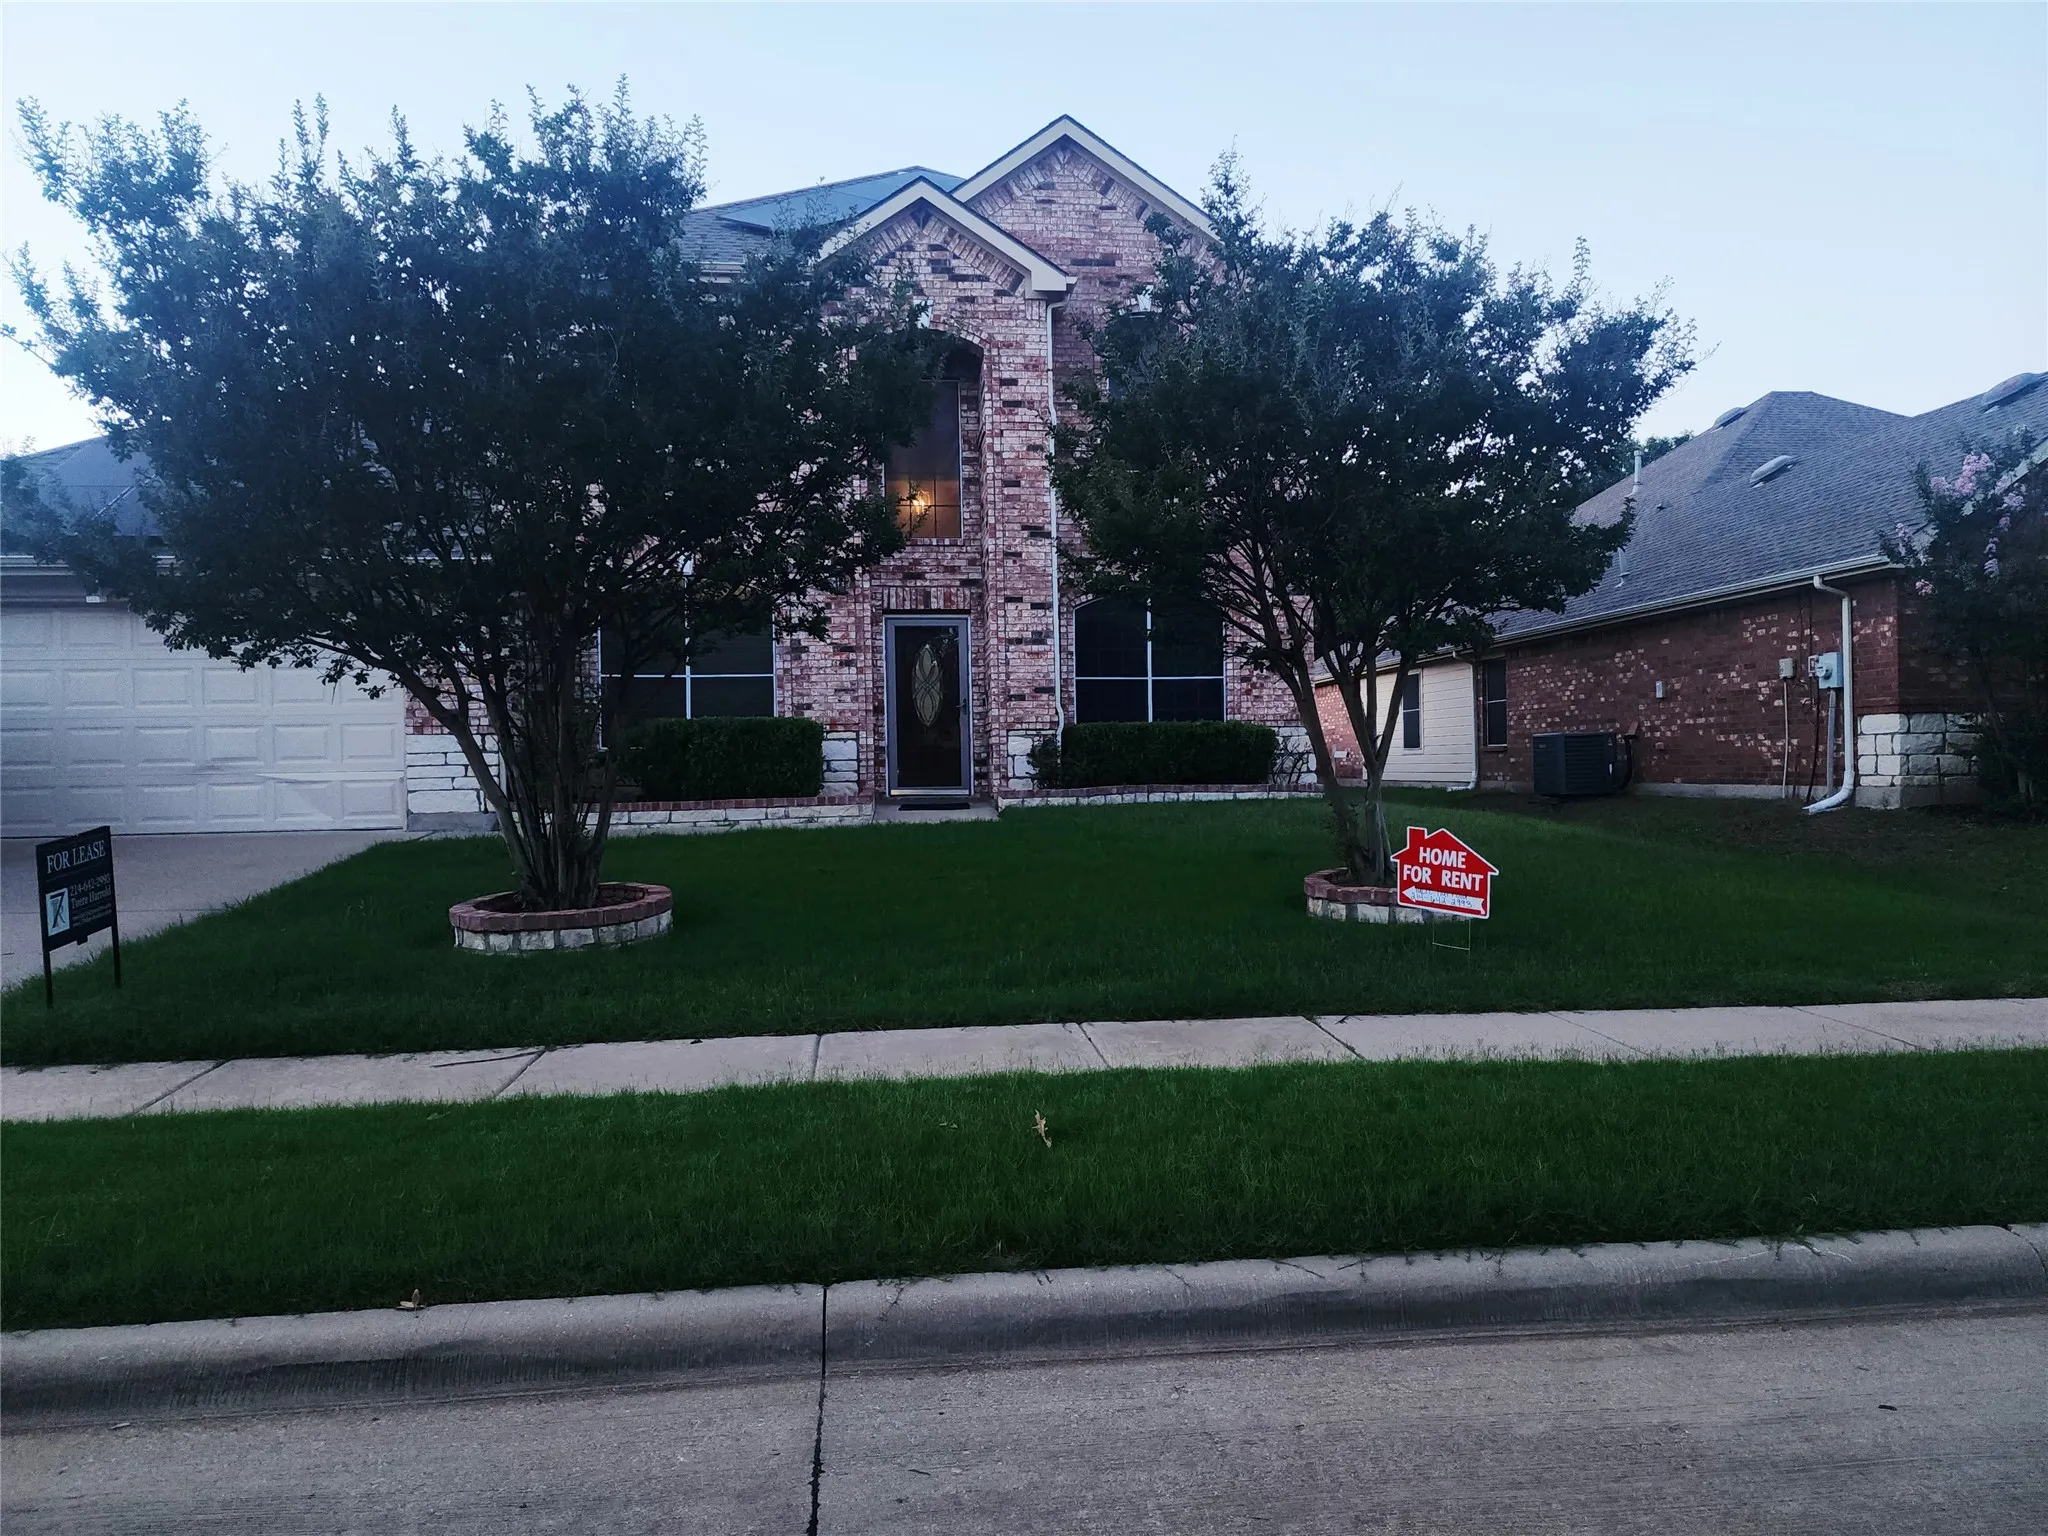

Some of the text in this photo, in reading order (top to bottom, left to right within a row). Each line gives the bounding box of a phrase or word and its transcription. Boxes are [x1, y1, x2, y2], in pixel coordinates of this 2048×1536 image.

[46, 840, 106, 874] FOR LEASE
[1419, 846, 1467, 869] HOME
[1403, 864, 1484, 891] FOR RENT
